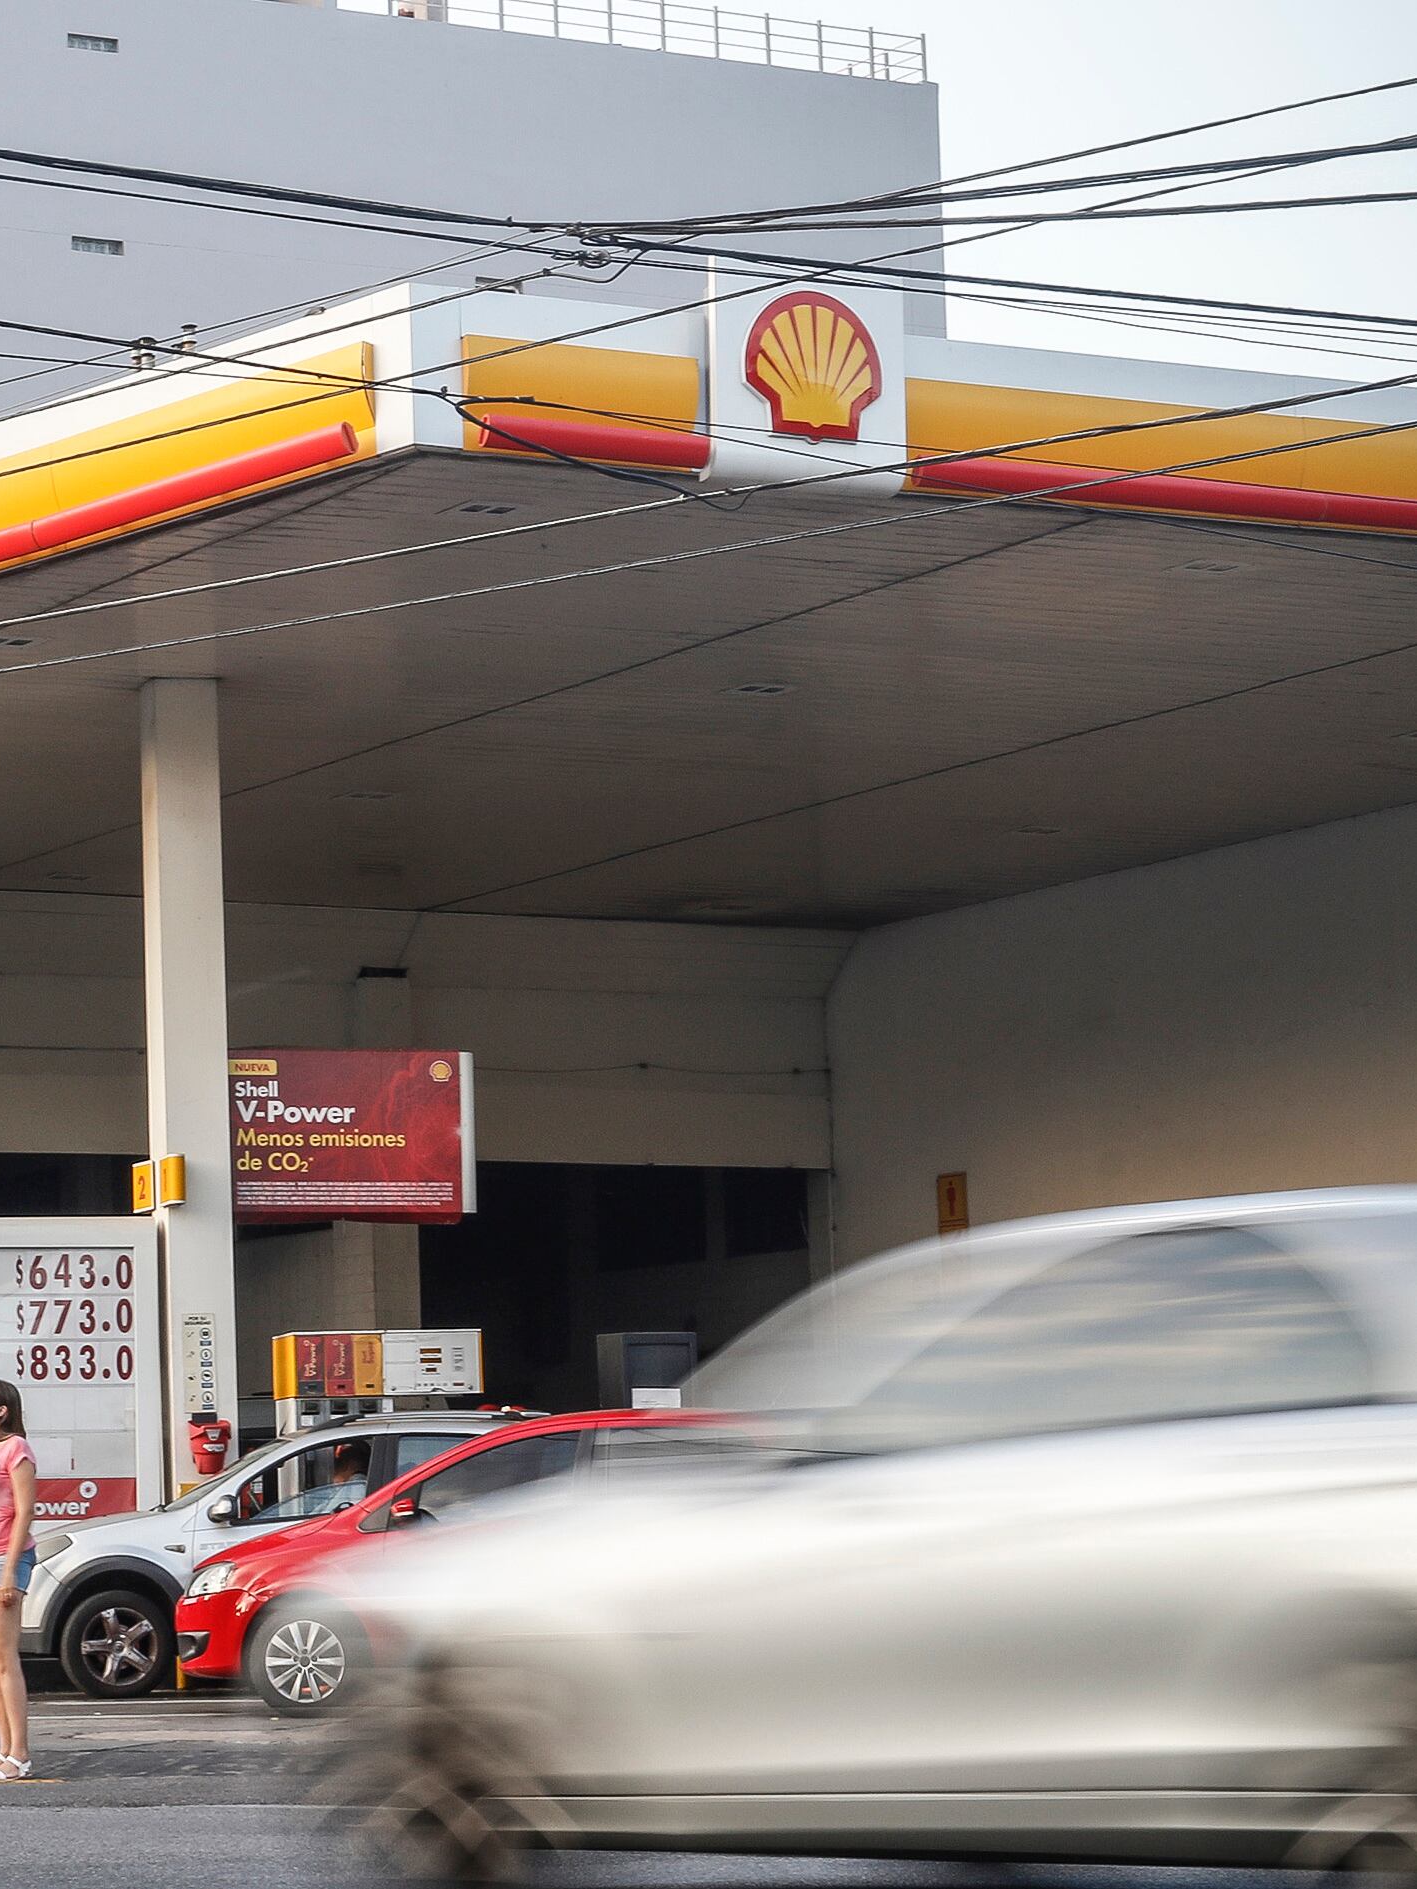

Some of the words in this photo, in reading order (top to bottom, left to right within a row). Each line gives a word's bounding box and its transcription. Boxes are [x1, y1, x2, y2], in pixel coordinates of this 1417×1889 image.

[235, 1063, 270, 1072] NUEVA
[235, 1081, 279, 1098] Shell
[236, 1101, 355, 1124] V-Power
[236, 1128, 304, 1147] Menos
[309, 1129, 406, 1147] emisiones
[236, 1151, 263, 1172] de
[16, 1254, 133, 1290] $643.0
[16, 1298, 133, 1335] $773.0
[16, 1345, 133, 1381] $833.0
[33, 1501, 91, 1516] ower
